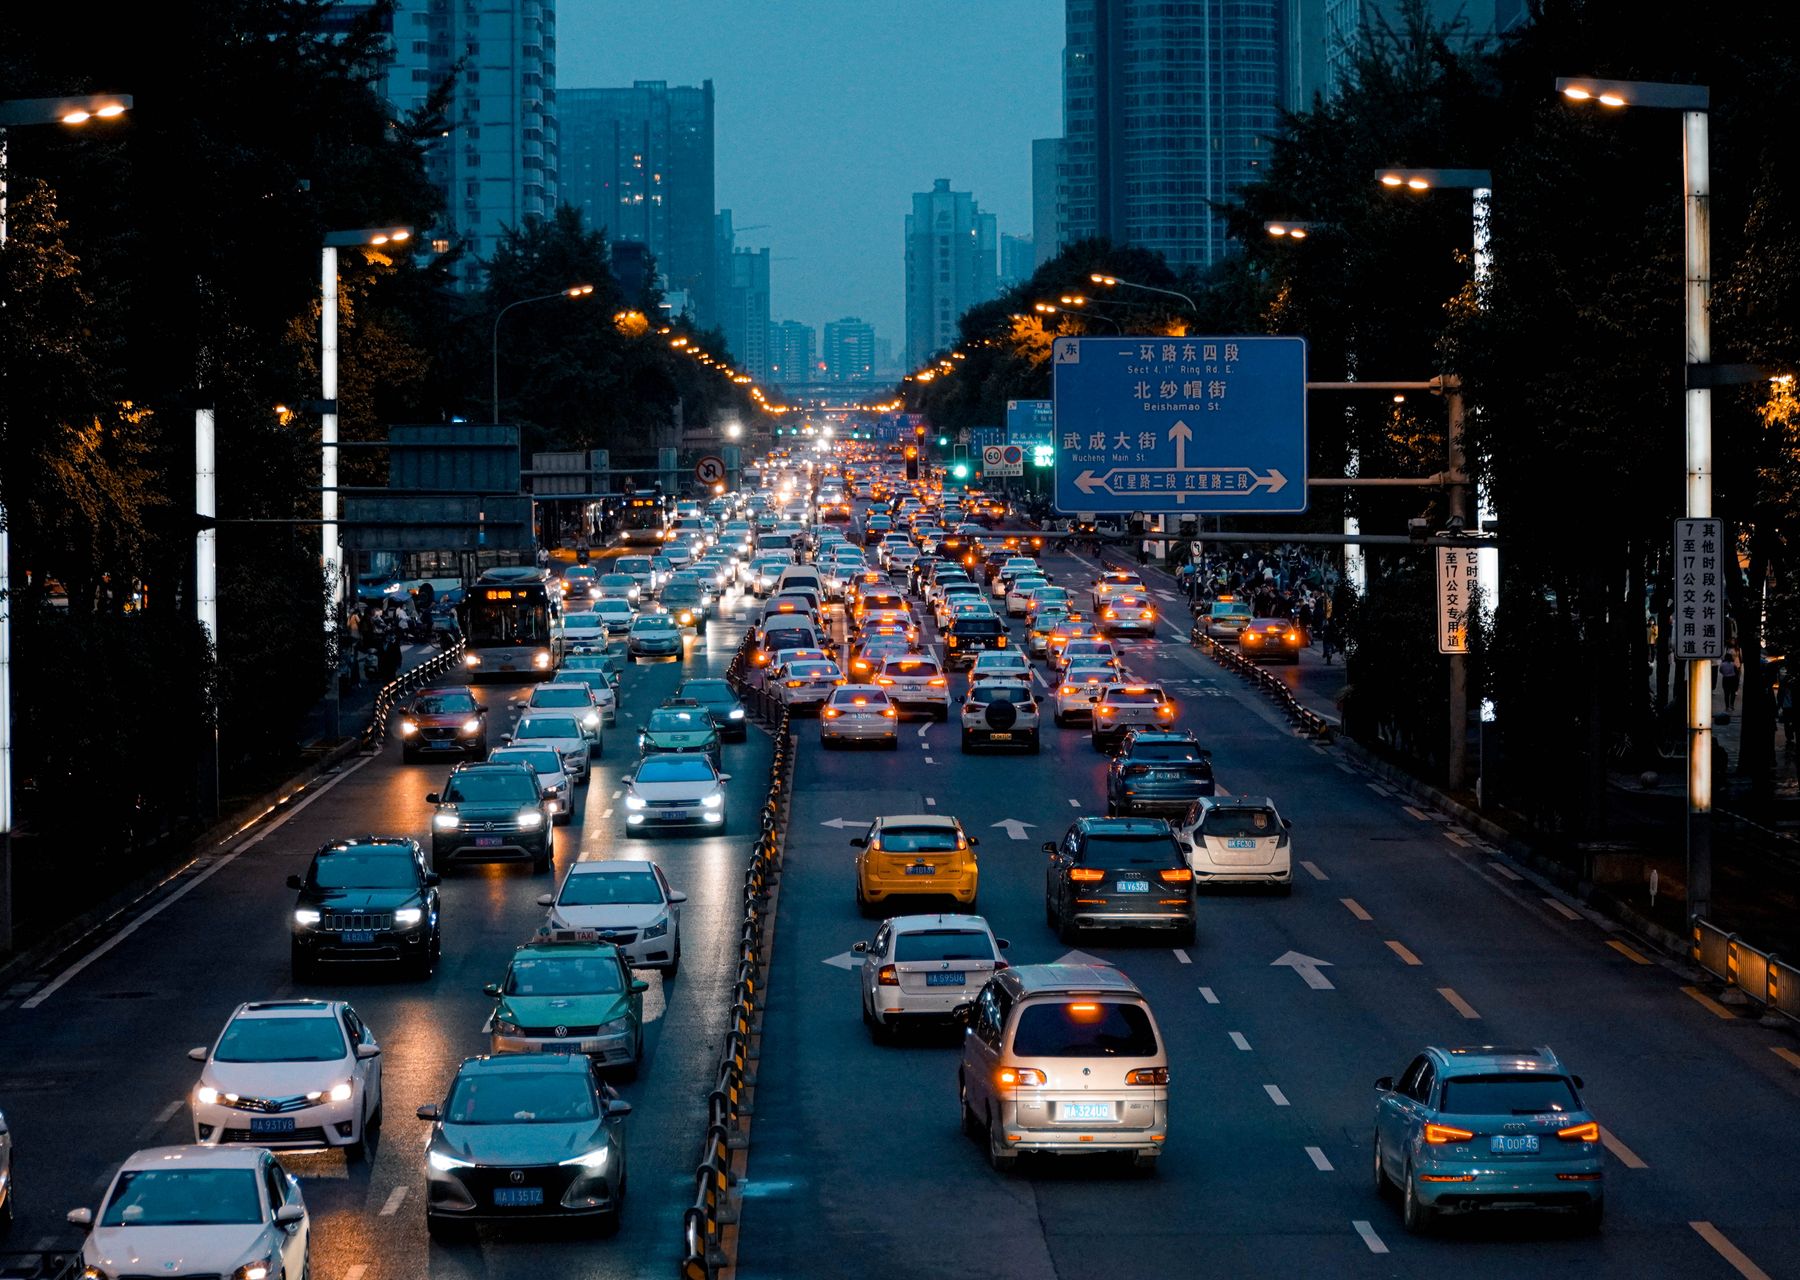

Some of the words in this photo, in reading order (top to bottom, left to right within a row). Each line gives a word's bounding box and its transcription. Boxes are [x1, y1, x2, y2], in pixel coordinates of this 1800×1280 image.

[1066, 342, 1077, 355] 东
[1118, 344, 1239, 362] 一环路东四段
[1127, 365, 1149, 374] Sect
[1180, 366, 1200, 376] Ring
[1134, 380, 1226, 399] 北纱帽街
[1144, 402, 1200, 411] Beishamao
[1063, 431, 1157, 450] 武成大街
[988, 451, 999, 460] 60
[1072, 453, 1105, 463] Wucheng
[1112, 453, 1129, 461] Main
[1113, 474, 1177, 489] 红星路二段
[1185, 474, 1248, 489] 红星路三段
[1445, 548, 1460, 647] 至17公交专用道
[576, 931, 594, 940] TAXI
